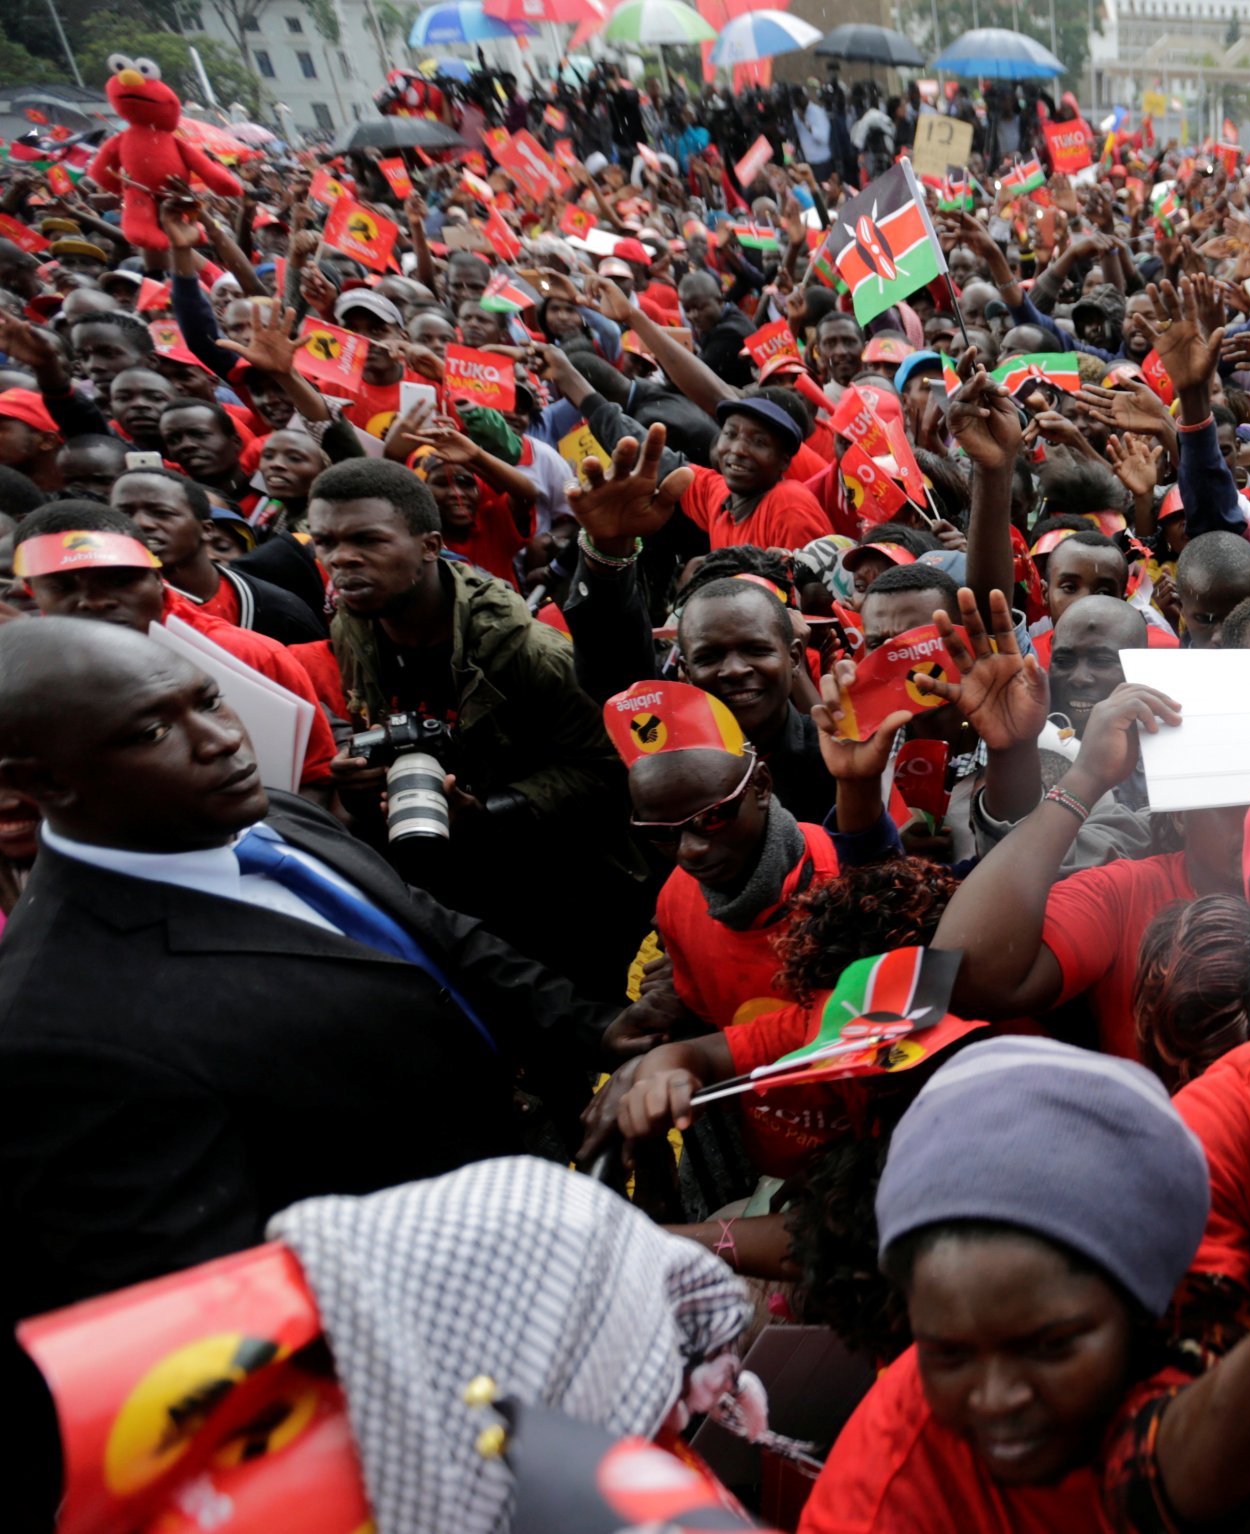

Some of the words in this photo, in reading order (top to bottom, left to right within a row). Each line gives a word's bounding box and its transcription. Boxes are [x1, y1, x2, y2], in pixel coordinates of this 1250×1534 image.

[1053, 130, 1085, 150] TUKO
[448, 356, 500, 382] TUKO
[888, 636, 944, 662] Jubilee
[616, 691, 664, 712] Jubilee
